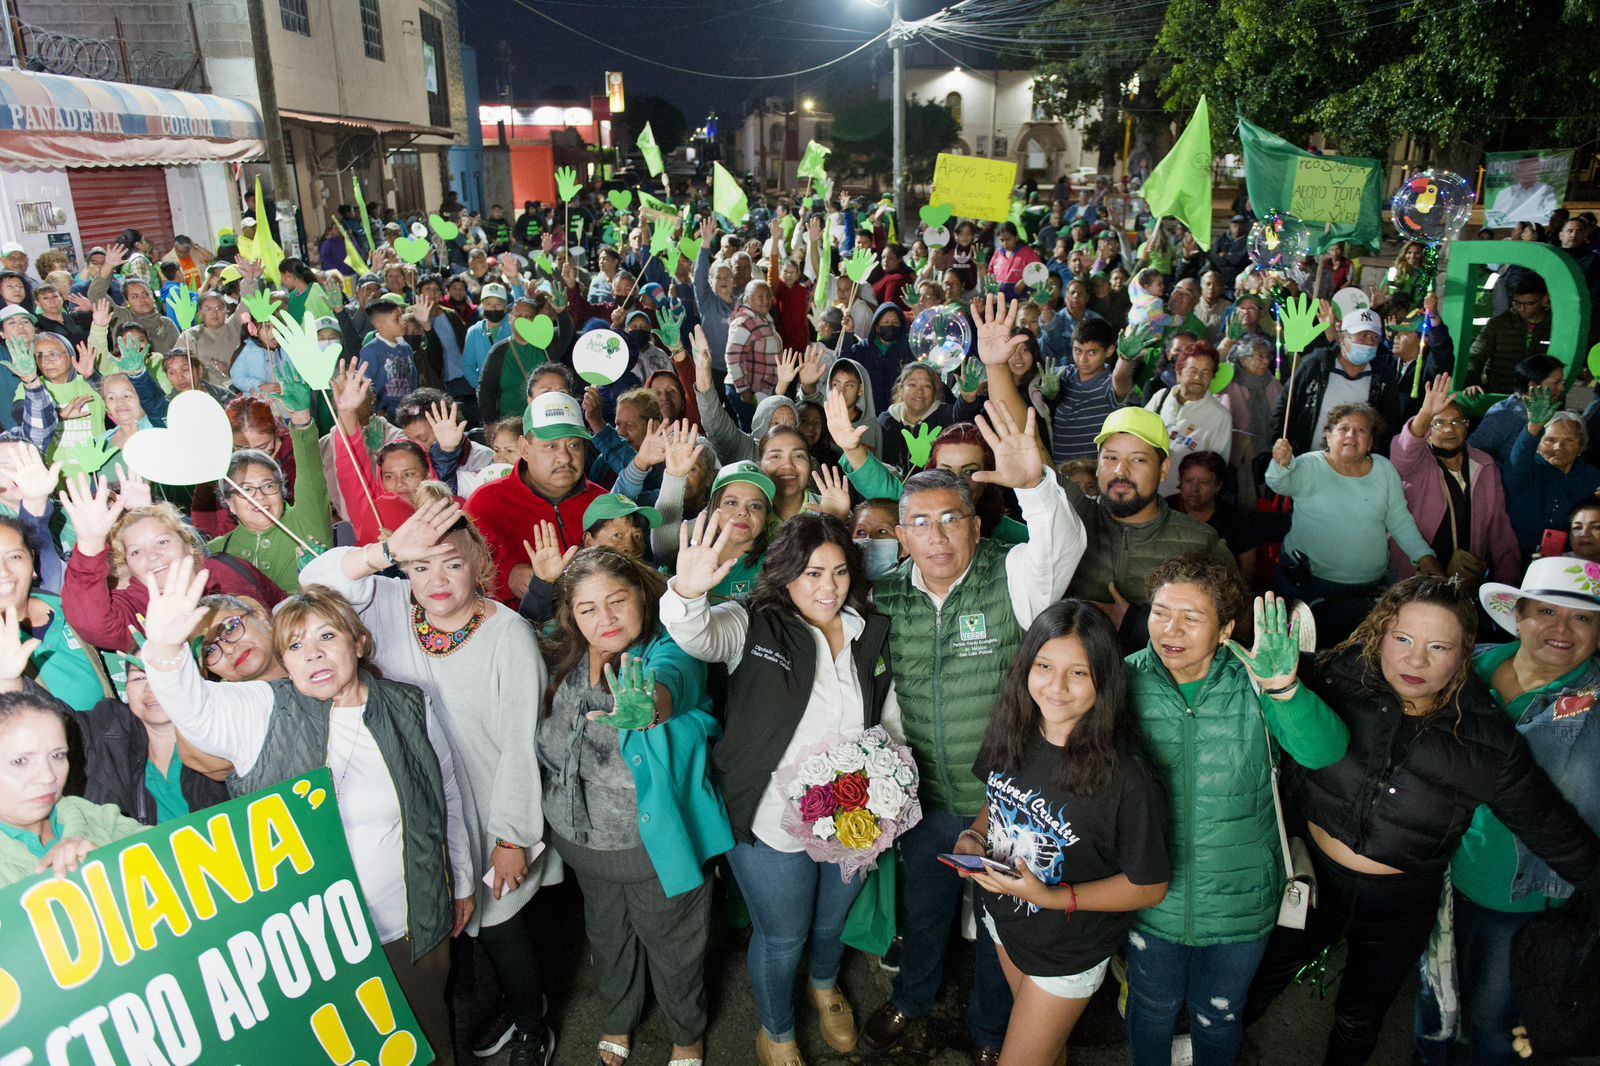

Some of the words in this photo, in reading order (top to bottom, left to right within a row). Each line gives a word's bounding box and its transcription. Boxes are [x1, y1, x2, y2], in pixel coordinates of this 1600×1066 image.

[9, 103, 124, 133] PANADERIA
[160, 114, 215, 137] CORONA
[938, 157, 977, 181] Apoyo
[961, 630, 986, 639] VERDE
[1031, 797, 1081, 847] Cruelty
[198, 879, 373, 1041] APOYO
